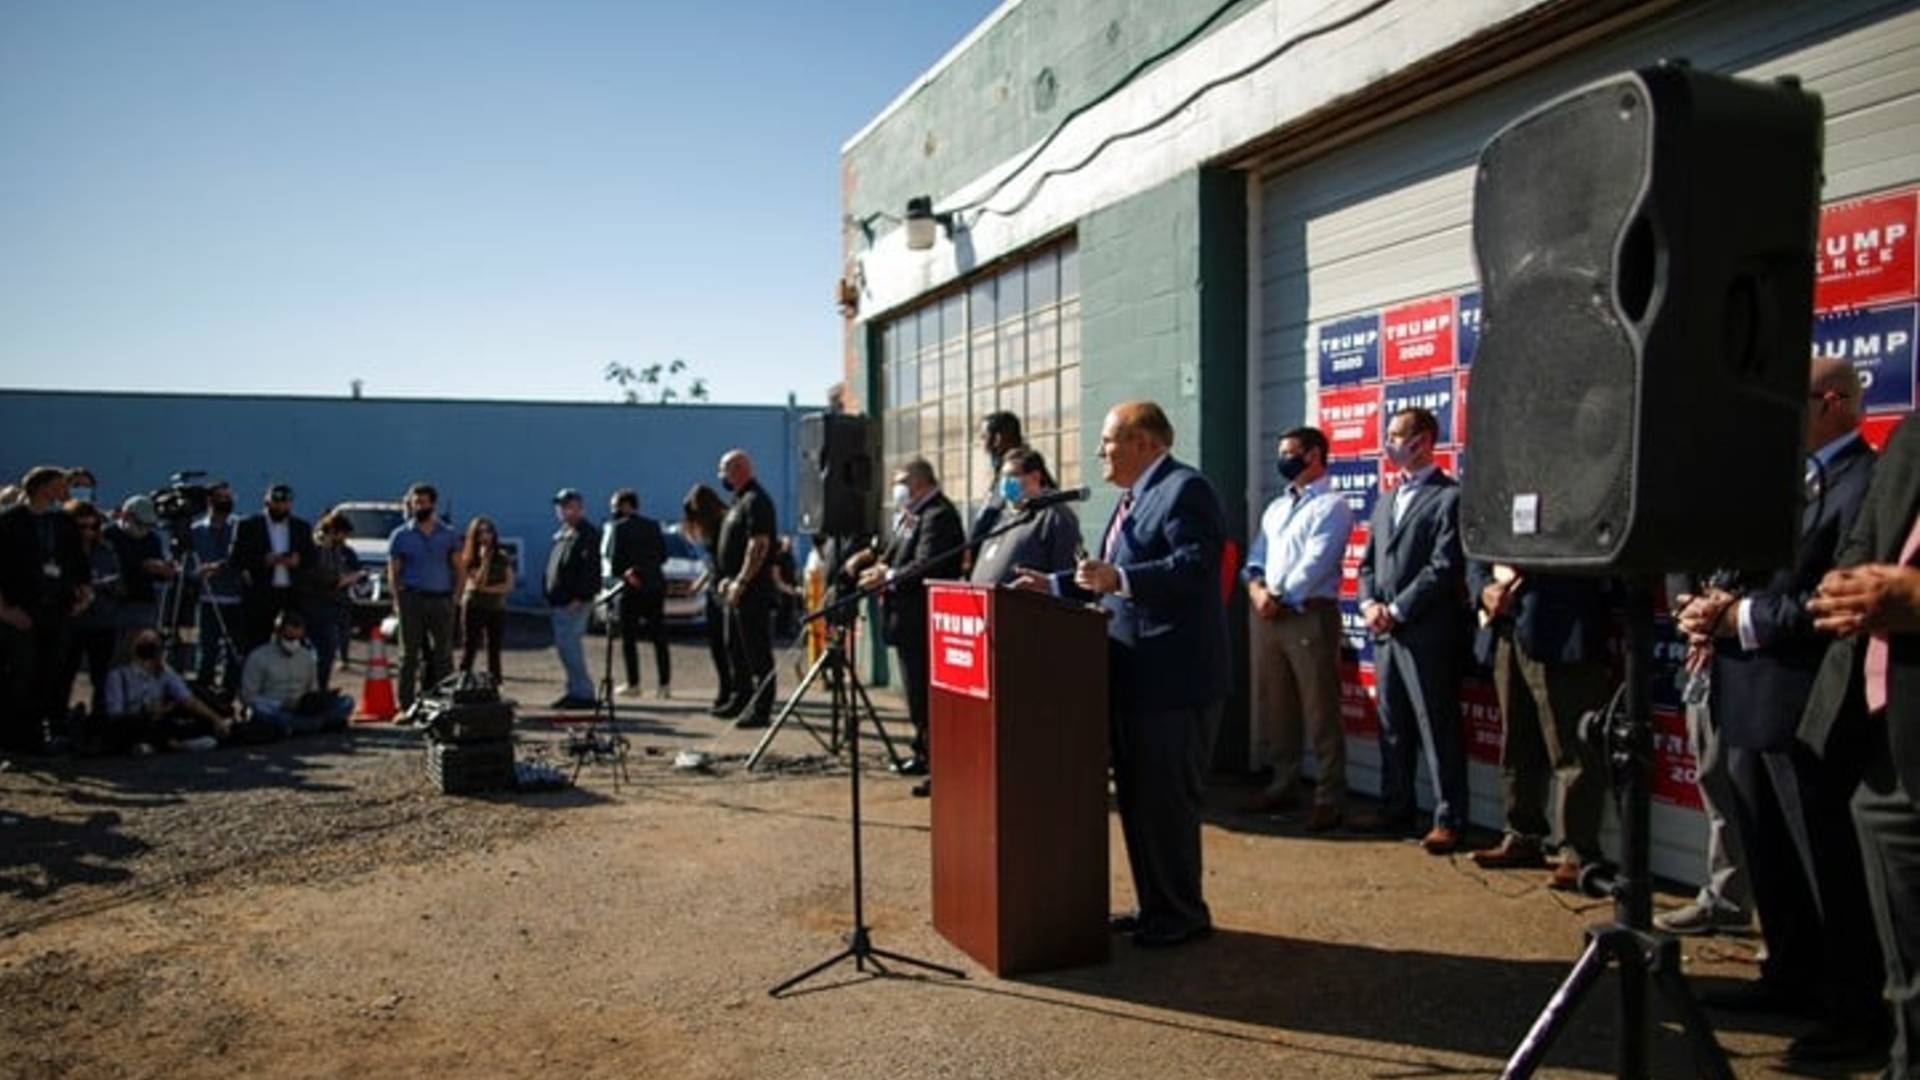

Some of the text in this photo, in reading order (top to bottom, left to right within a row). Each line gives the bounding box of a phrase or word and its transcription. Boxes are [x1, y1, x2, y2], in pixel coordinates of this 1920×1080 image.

[1826, 223, 1908, 257] UMP
[1816, 247, 1894, 275] ENCE
[1386, 315, 1450, 340] TRUMP
[1321, 330, 1377, 353] TRUMP
[1398, 342, 1435, 360] 2020
[1813, 331, 1908, 360] UMP
[1332, 355, 1364, 372] 2020
[1321, 401, 1377, 421] TRUMP
[1330, 472, 1377, 489] RUMP
[933, 611, 985, 637] TRUMP
[1460, 701, 1499, 721] TRU
[1669, 766, 1698, 784] 20
